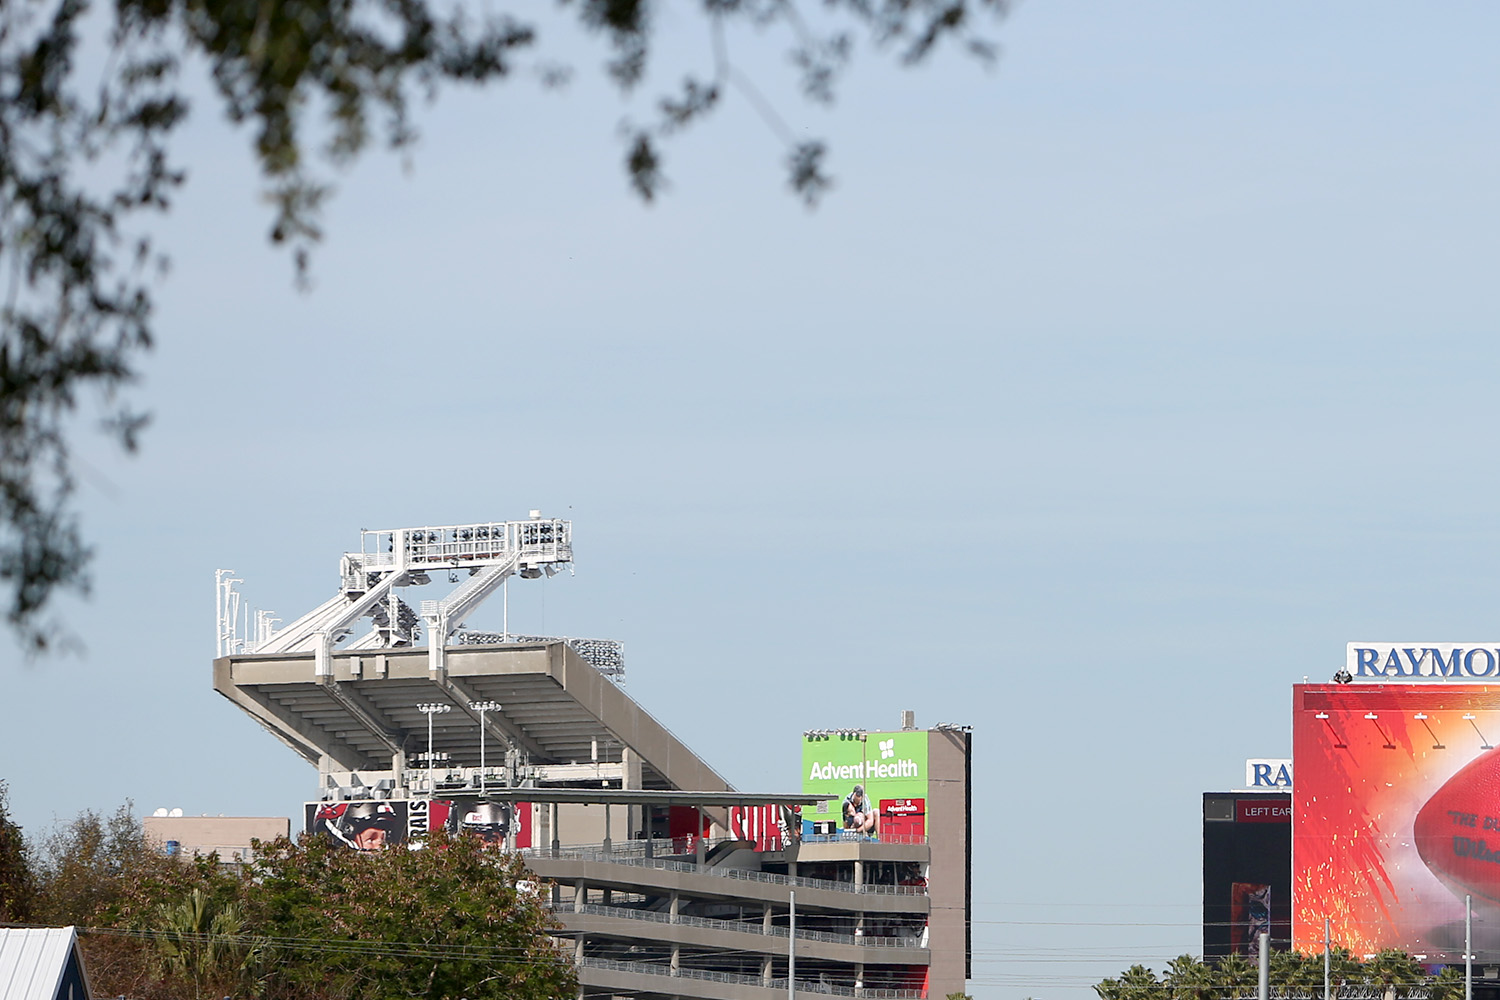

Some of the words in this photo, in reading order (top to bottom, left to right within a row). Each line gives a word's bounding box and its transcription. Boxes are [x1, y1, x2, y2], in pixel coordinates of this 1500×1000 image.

[809, 758, 918, 780] AdventHealth
[1251, 763, 1292, 787] RA
[1245, 807, 1270, 817] LEFT
